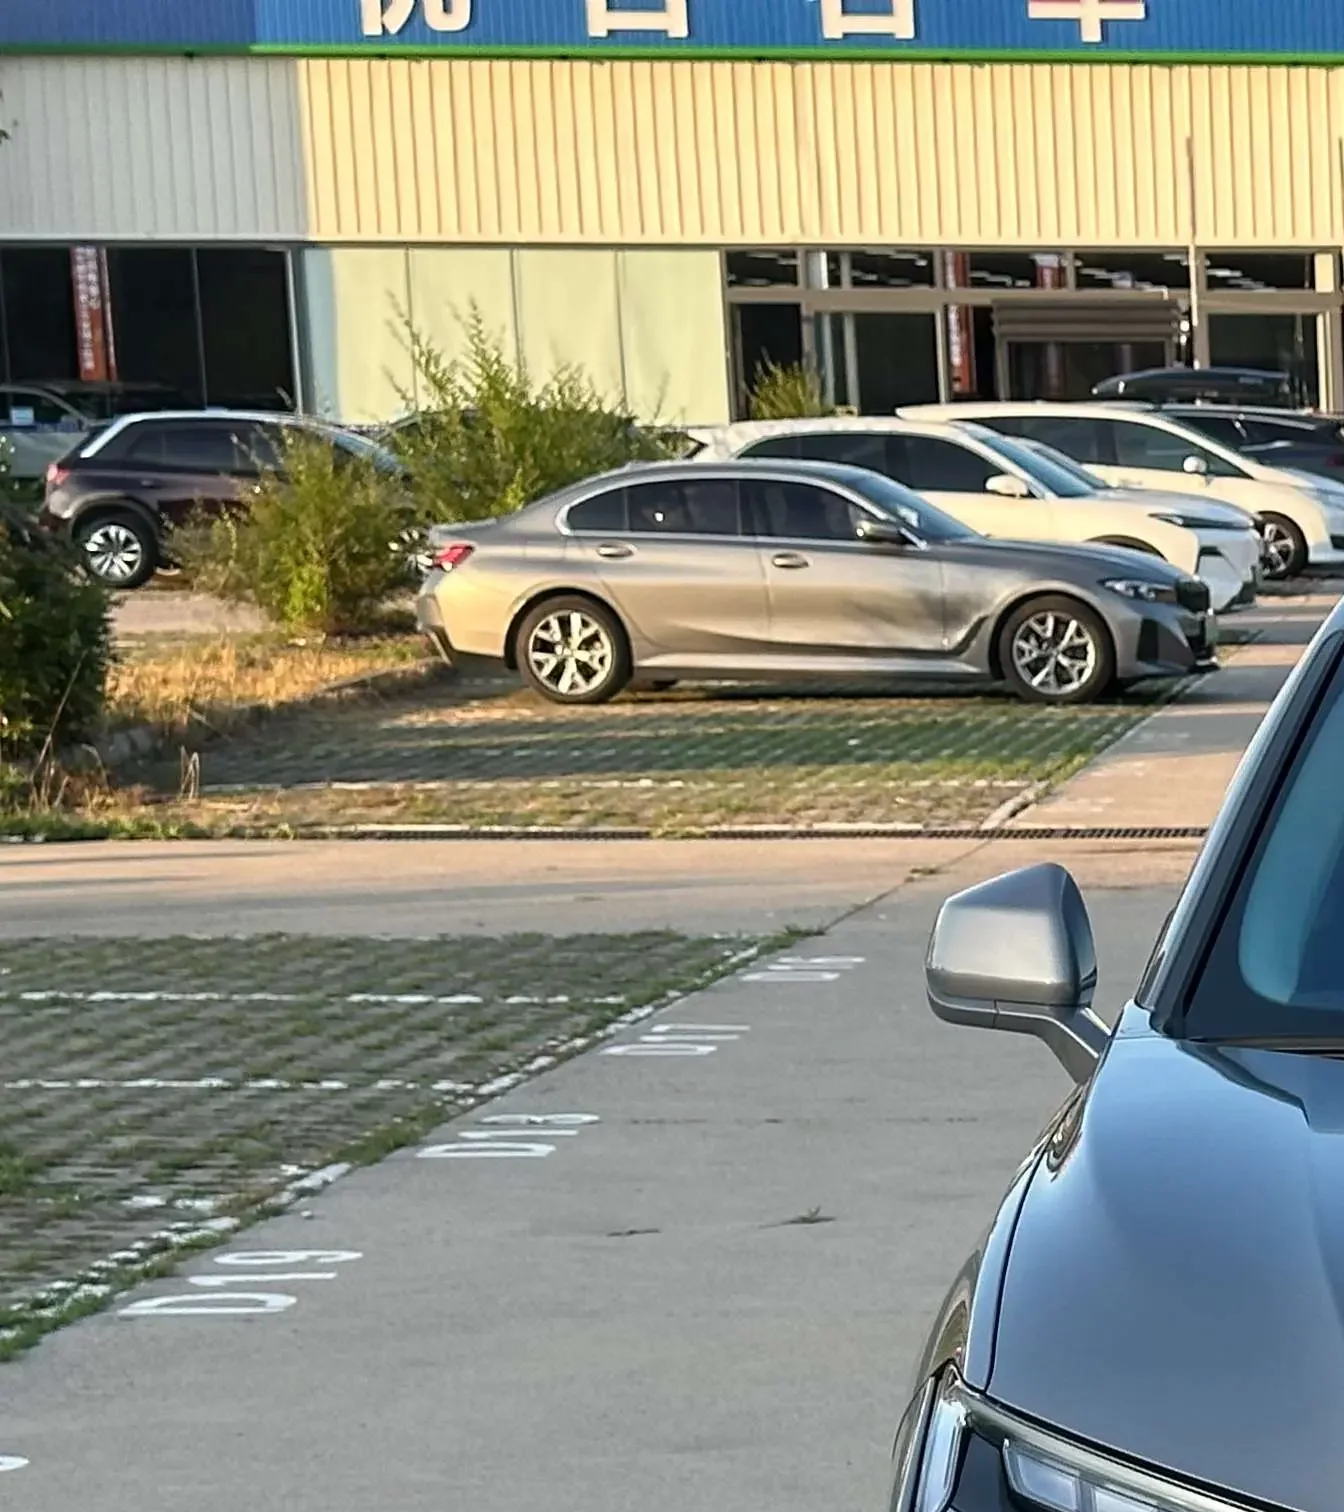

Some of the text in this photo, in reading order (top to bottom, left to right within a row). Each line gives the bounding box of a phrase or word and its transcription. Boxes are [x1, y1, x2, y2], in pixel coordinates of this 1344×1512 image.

[604, 1023, 751, 1056] D17
[416, 1113, 600, 1158] D18
[117, 1250, 364, 1315] D19
